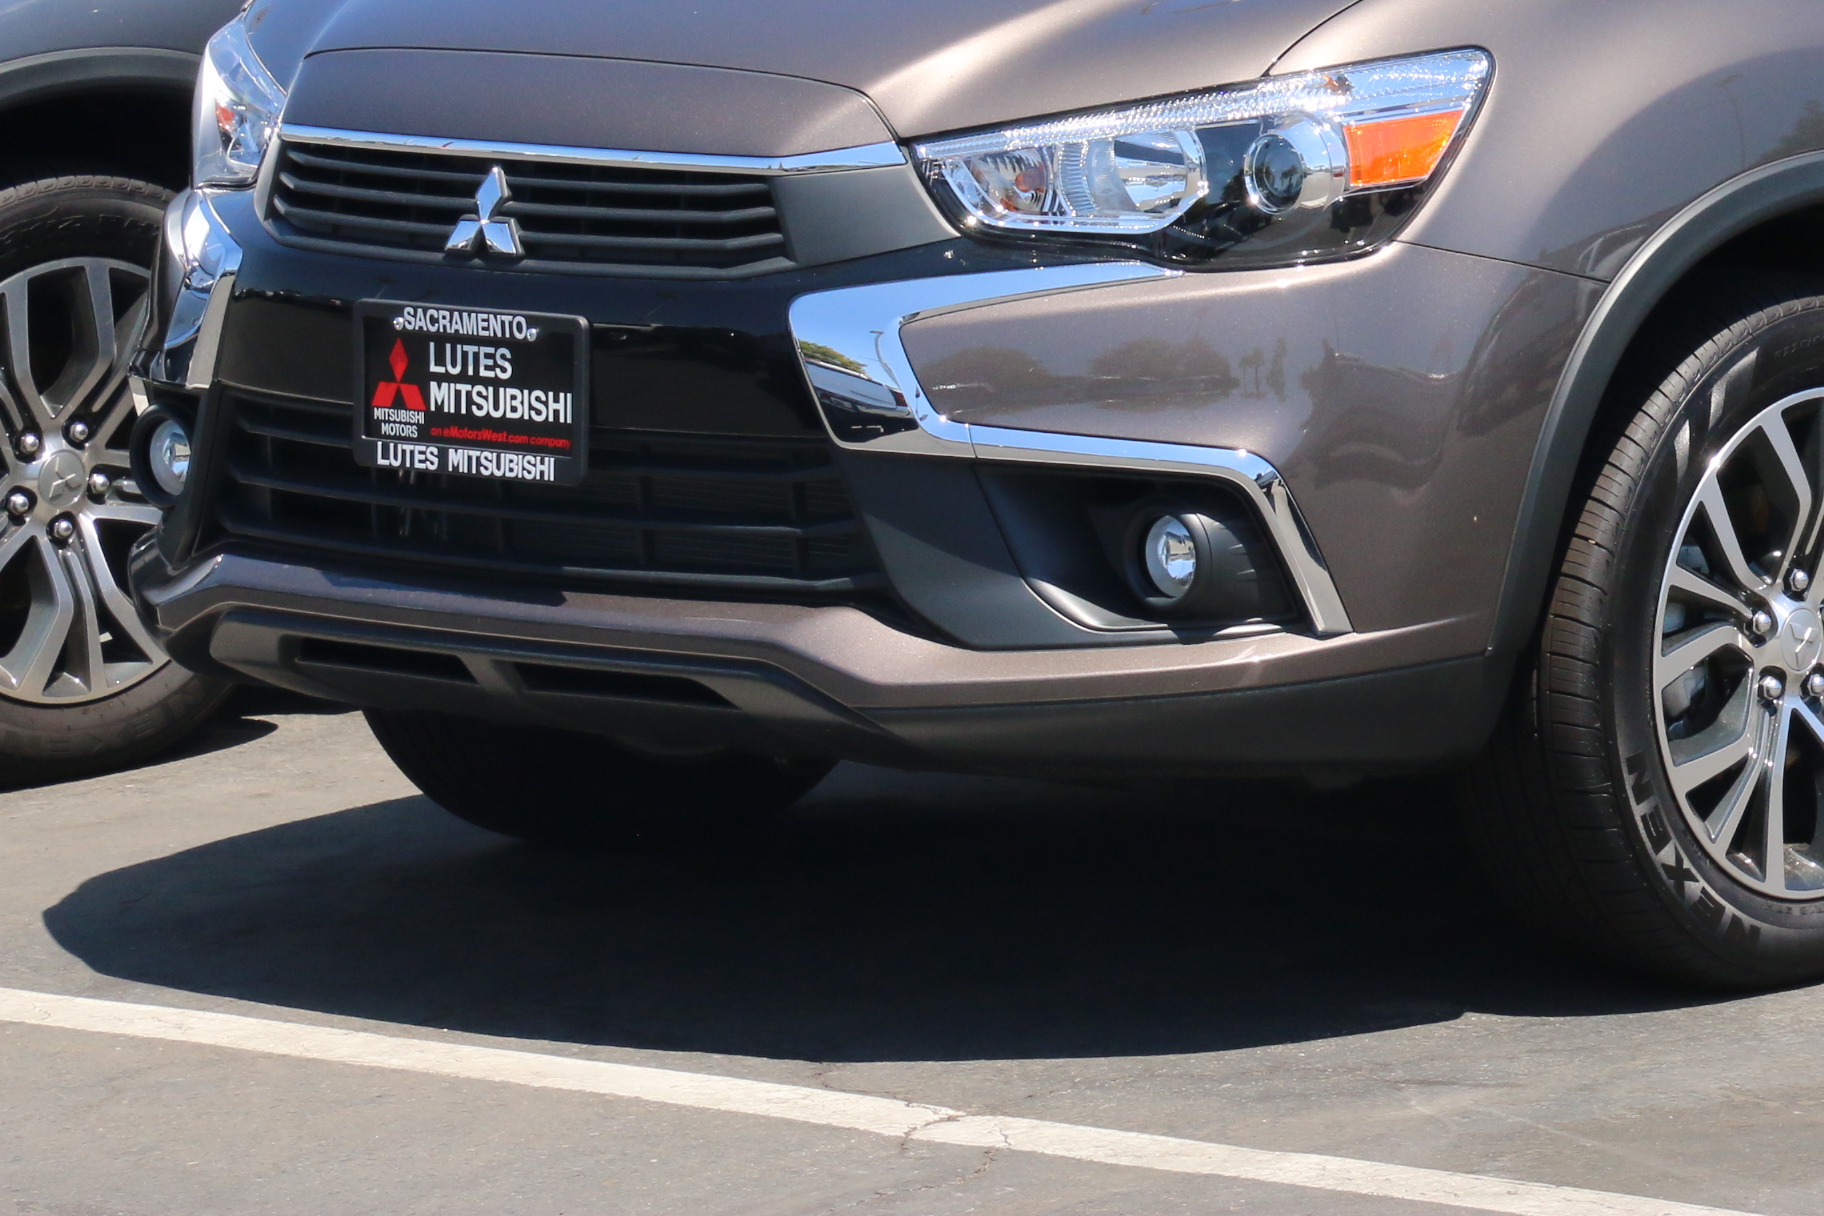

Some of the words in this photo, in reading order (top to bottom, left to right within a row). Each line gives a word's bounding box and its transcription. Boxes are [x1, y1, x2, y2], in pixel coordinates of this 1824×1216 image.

[403, 307, 528, 340] SACRAMENTO
[429, 341, 513, 380] LUTES
[373, 407, 425, 425] MITSUBISHI
[429, 381, 573, 424] MITSUBISHI
[381, 422, 418, 438] MOTORS
[529, 435, 572, 450] company
[376, 441, 439, 471] LUTES
[448, 448, 555, 482] MITSUBISHI
